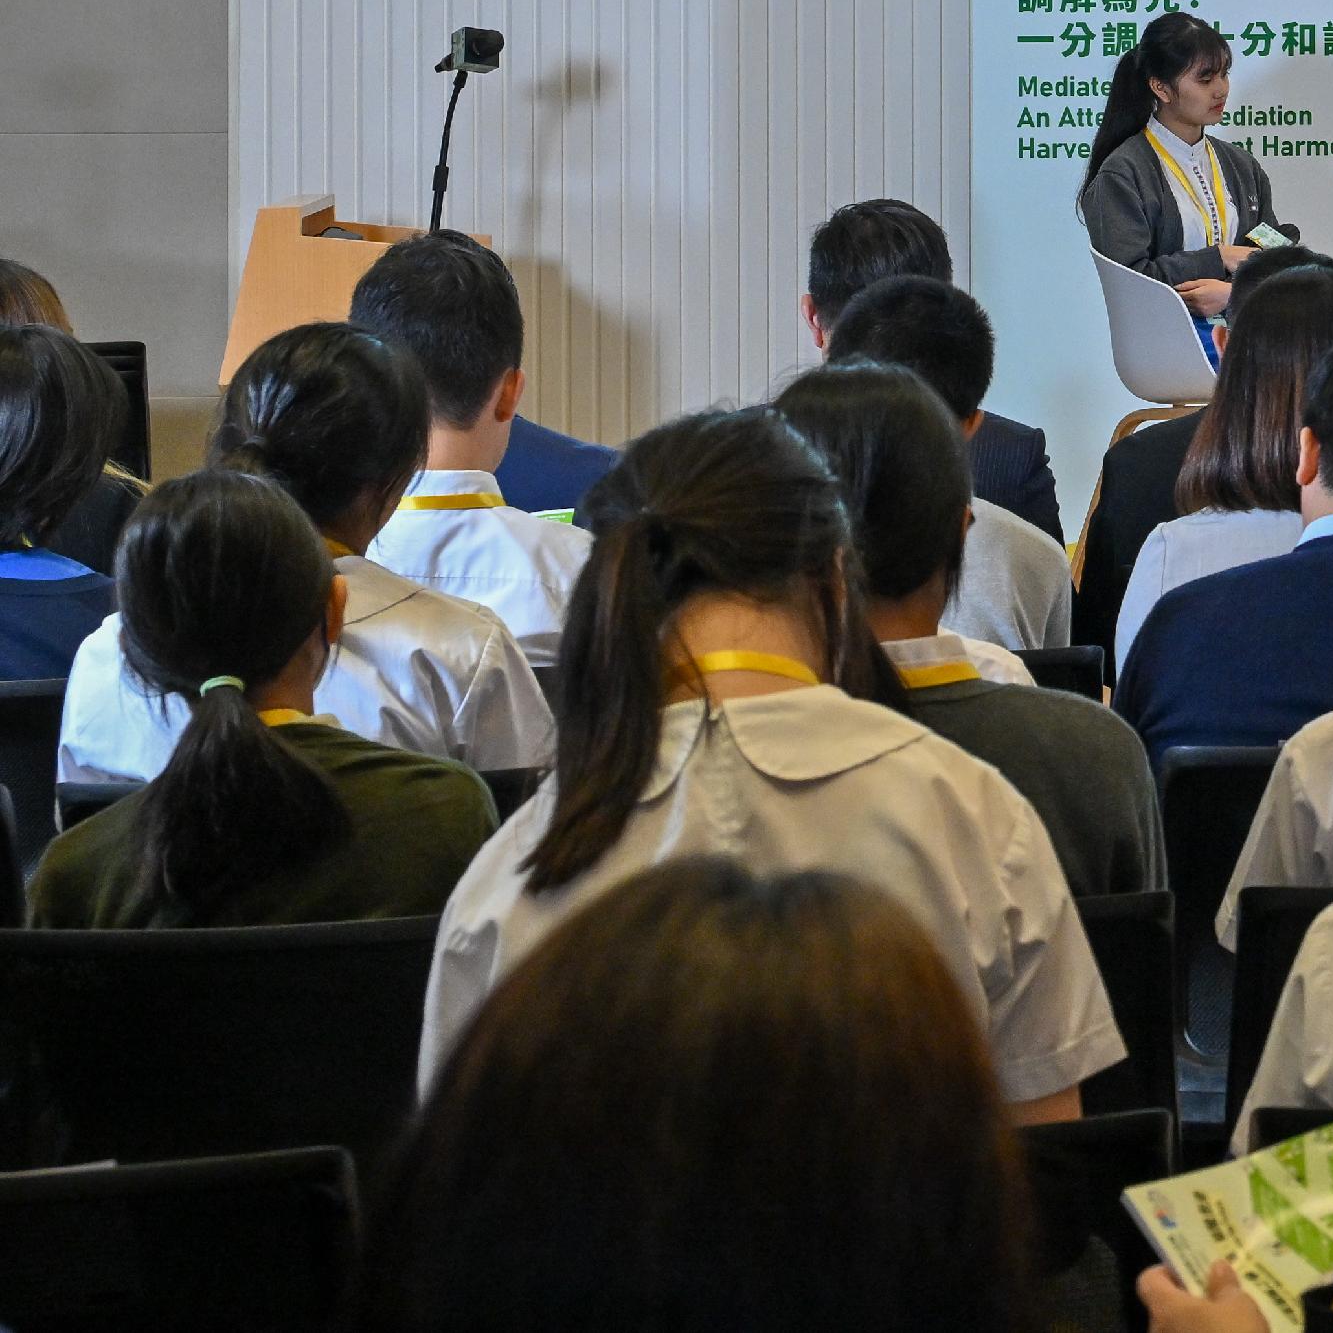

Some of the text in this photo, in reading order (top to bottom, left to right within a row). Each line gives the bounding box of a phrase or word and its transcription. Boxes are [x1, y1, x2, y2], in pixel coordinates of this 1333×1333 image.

[1017, 22, 1136, 57] 一分調
[1017, 106, 1312, 128] An ediation
